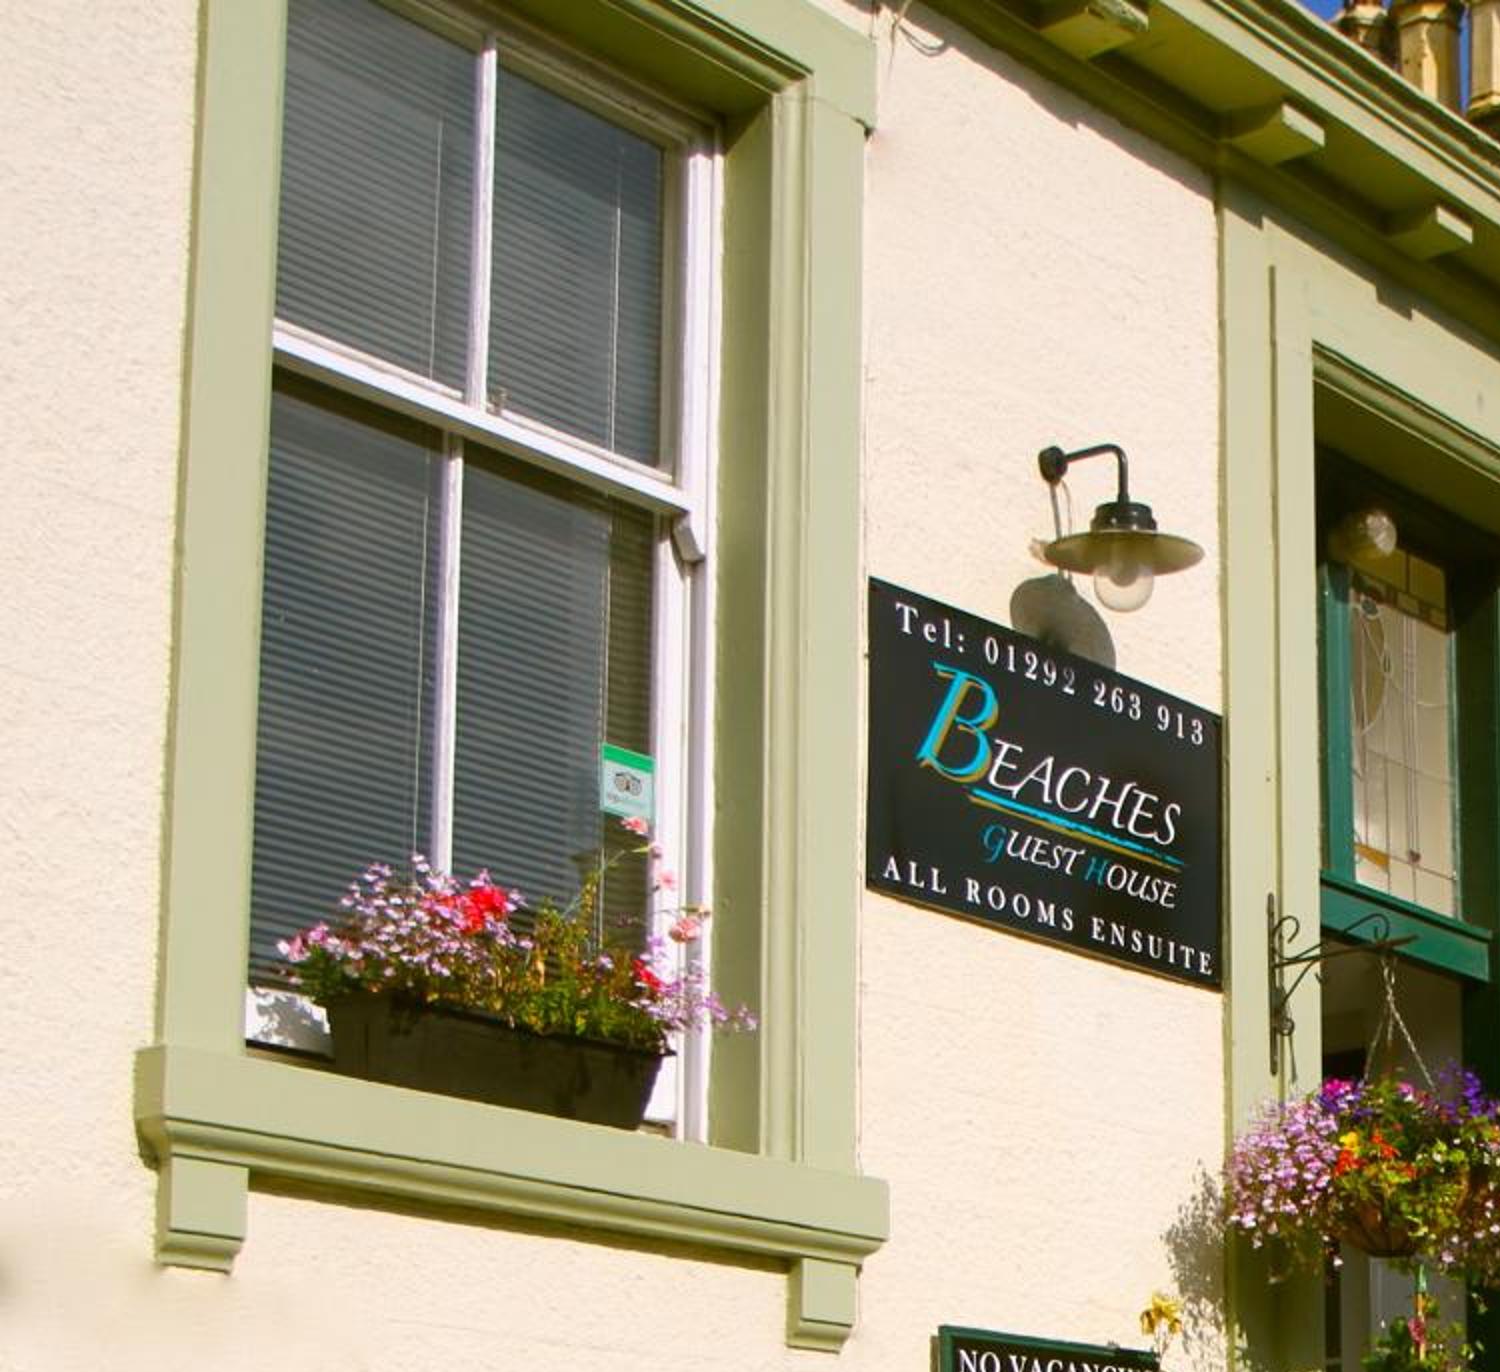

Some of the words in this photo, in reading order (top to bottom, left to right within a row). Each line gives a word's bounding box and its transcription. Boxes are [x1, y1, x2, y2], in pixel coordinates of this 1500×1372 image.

[895, 601, 965, 653] Tel:
[983, 635, 1077, 696] 01292
[1092, 682, 1142, 721] 263
[1156, 703, 1205, 745] 913
[915, 659, 1182, 846] BEACHES
[882, 855, 947, 895] ALL
[965, 877, 1075, 931] ROOMS
[1092, 916, 1213, 977] ENSUITE
[981, 822, 1086, 877] GUEST
[1084, 855, 1178, 909] HOUSE
